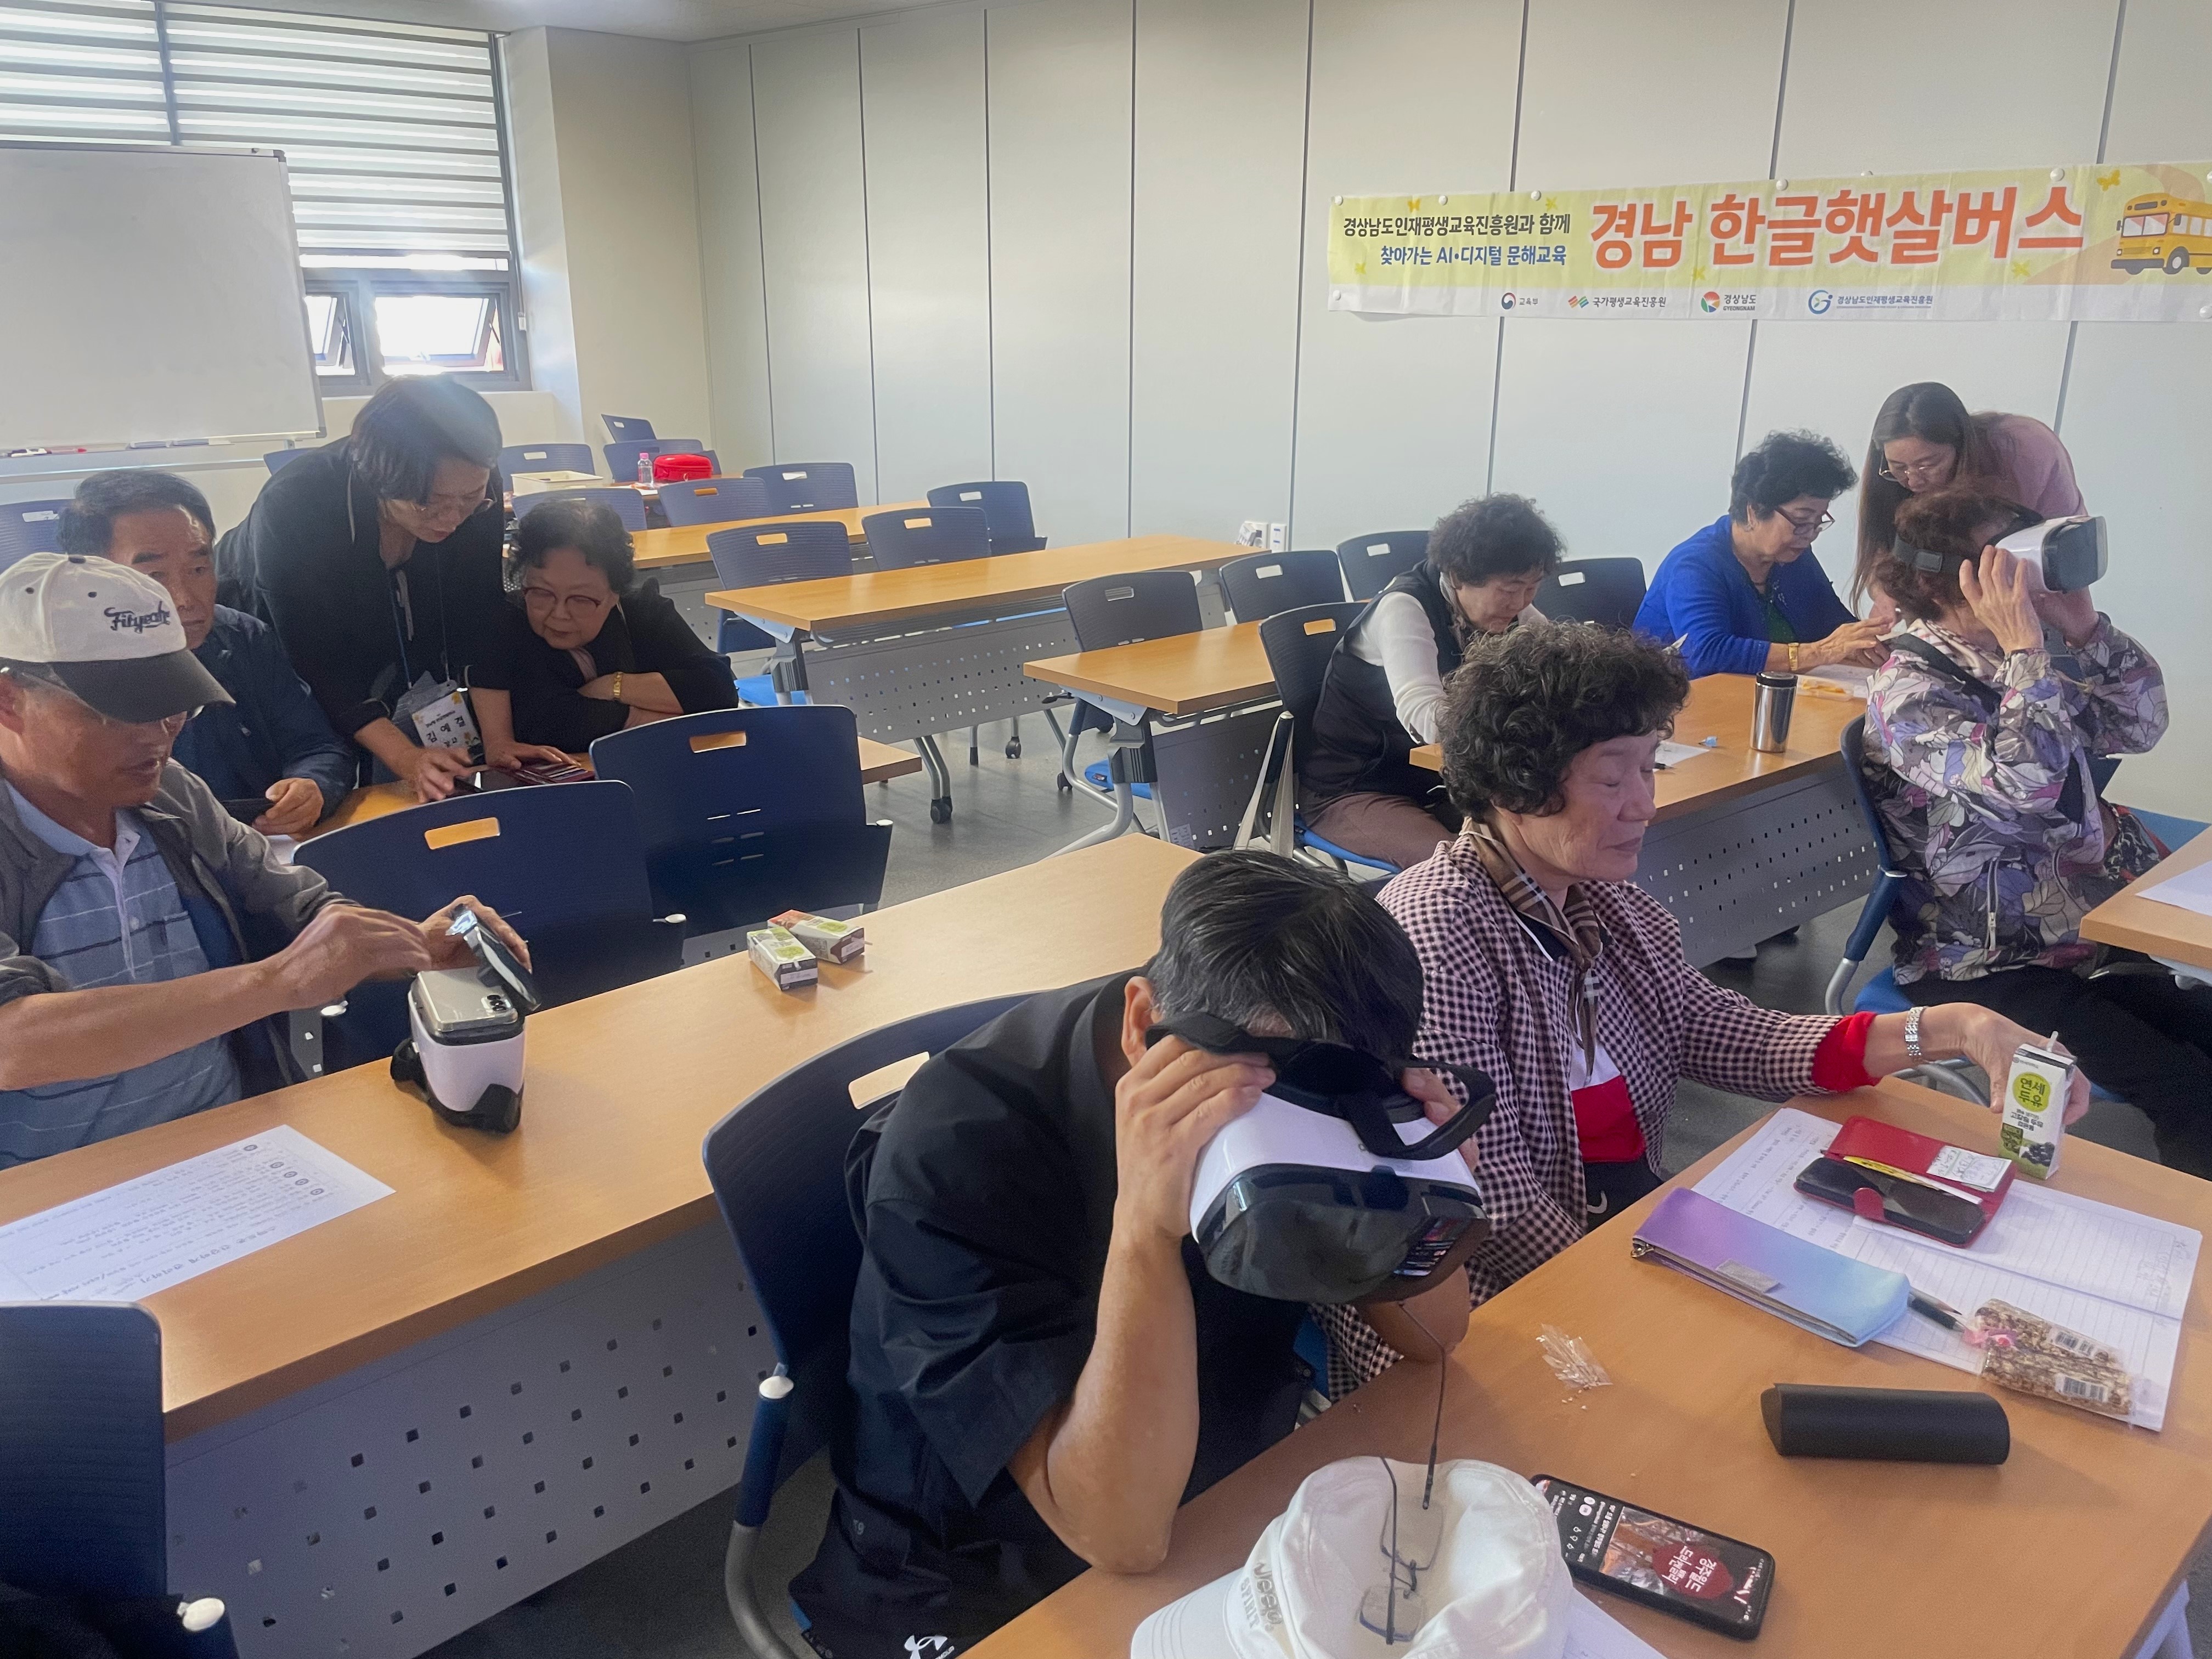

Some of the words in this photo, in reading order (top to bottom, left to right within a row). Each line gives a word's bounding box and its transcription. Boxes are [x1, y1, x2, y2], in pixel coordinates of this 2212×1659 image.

[1344, 214, 1534, 238] 경상남도인재평생교육진흥원과
[1539, 213, 1570, 235] 함께
[1590, 198, 1692, 269] 경남
[1709, 187, 2084, 267] 한글햇살버스
[1380, 245, 1432, 266] 찾아가는
[1506, 245, 1567, 266] 문해교육
[1592, 296, 1667, 308] 국가평생교육진흥원
[1724, 295, 1757, 304] 경상남도
[1837, 295, 1933, 305] 경상남도인재평생교육진흥원
[2021, 1078, 2045, 1094] 연세
[2018, 1091, 2042, 1107] 두유
[1685, 1558, 1717, 1592] 경주월드
